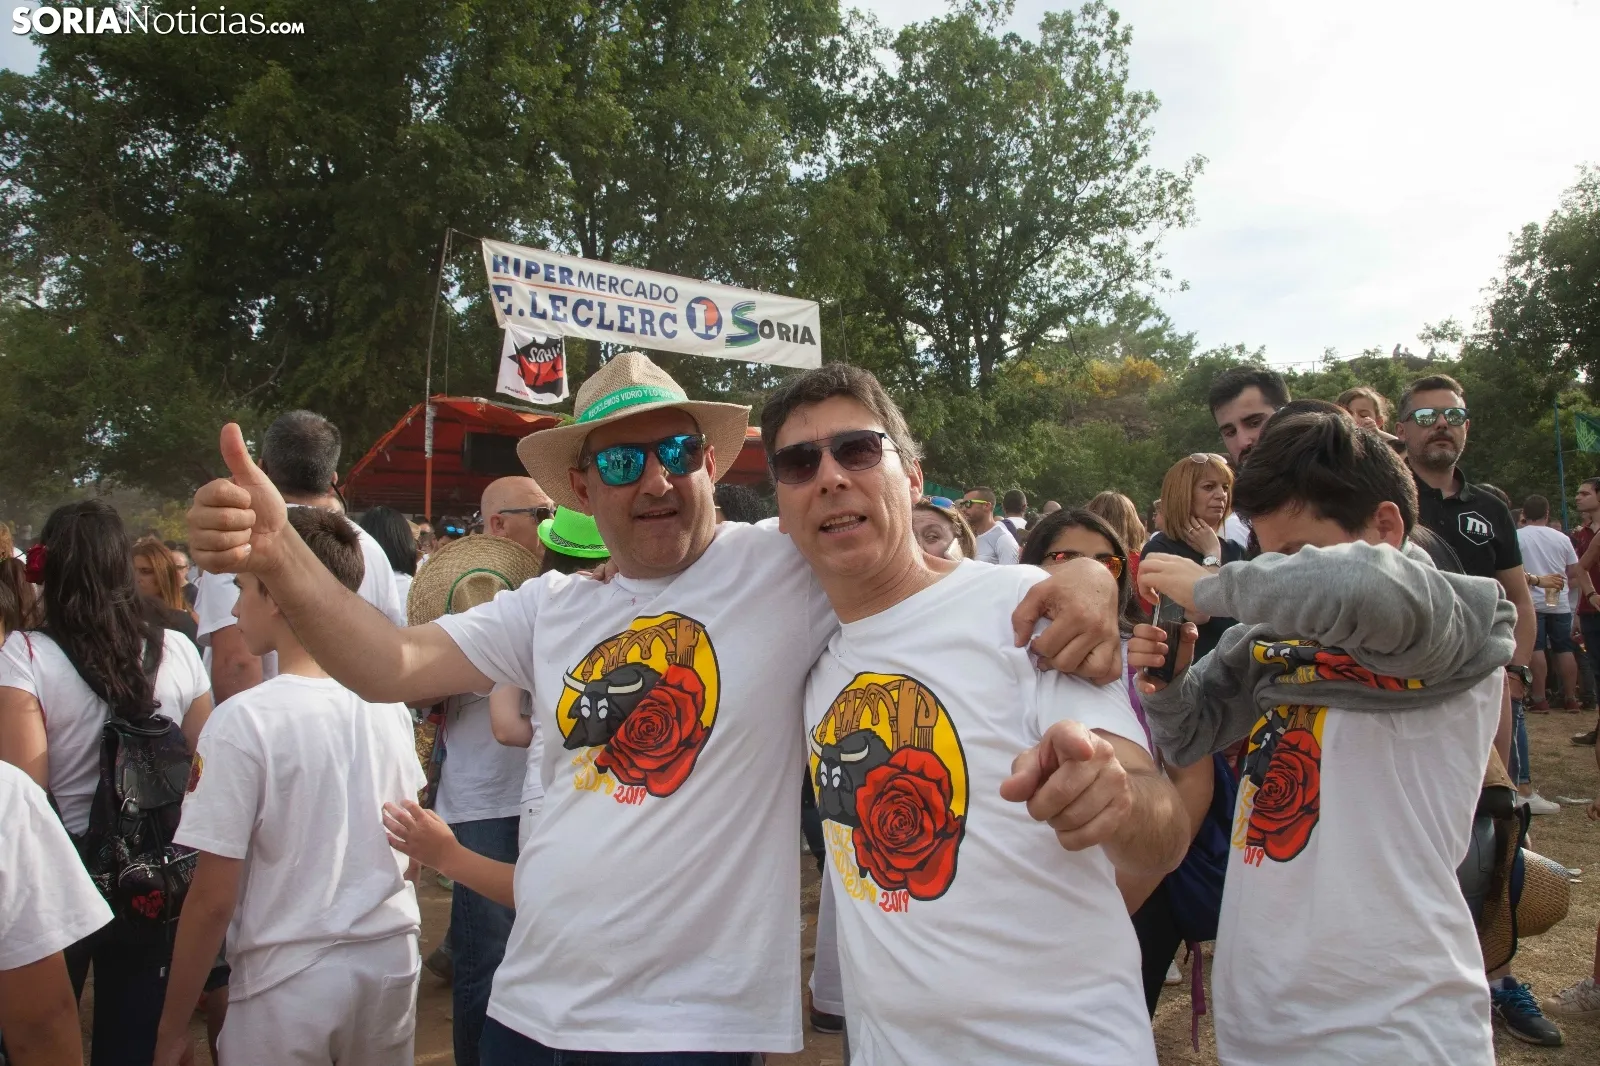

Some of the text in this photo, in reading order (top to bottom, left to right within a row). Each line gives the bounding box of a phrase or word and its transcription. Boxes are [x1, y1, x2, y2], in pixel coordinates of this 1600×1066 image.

[492, 254, 679, 304] HIPERMERCADO
[492, 284, 678, 340] E.LECLERC
[620, 389, 643, 401] VIDRIO
[613, 785, 648, 806] 2019
[1243, 845, 1265, 868] 019
[879, 890, 910, 913] 2019
